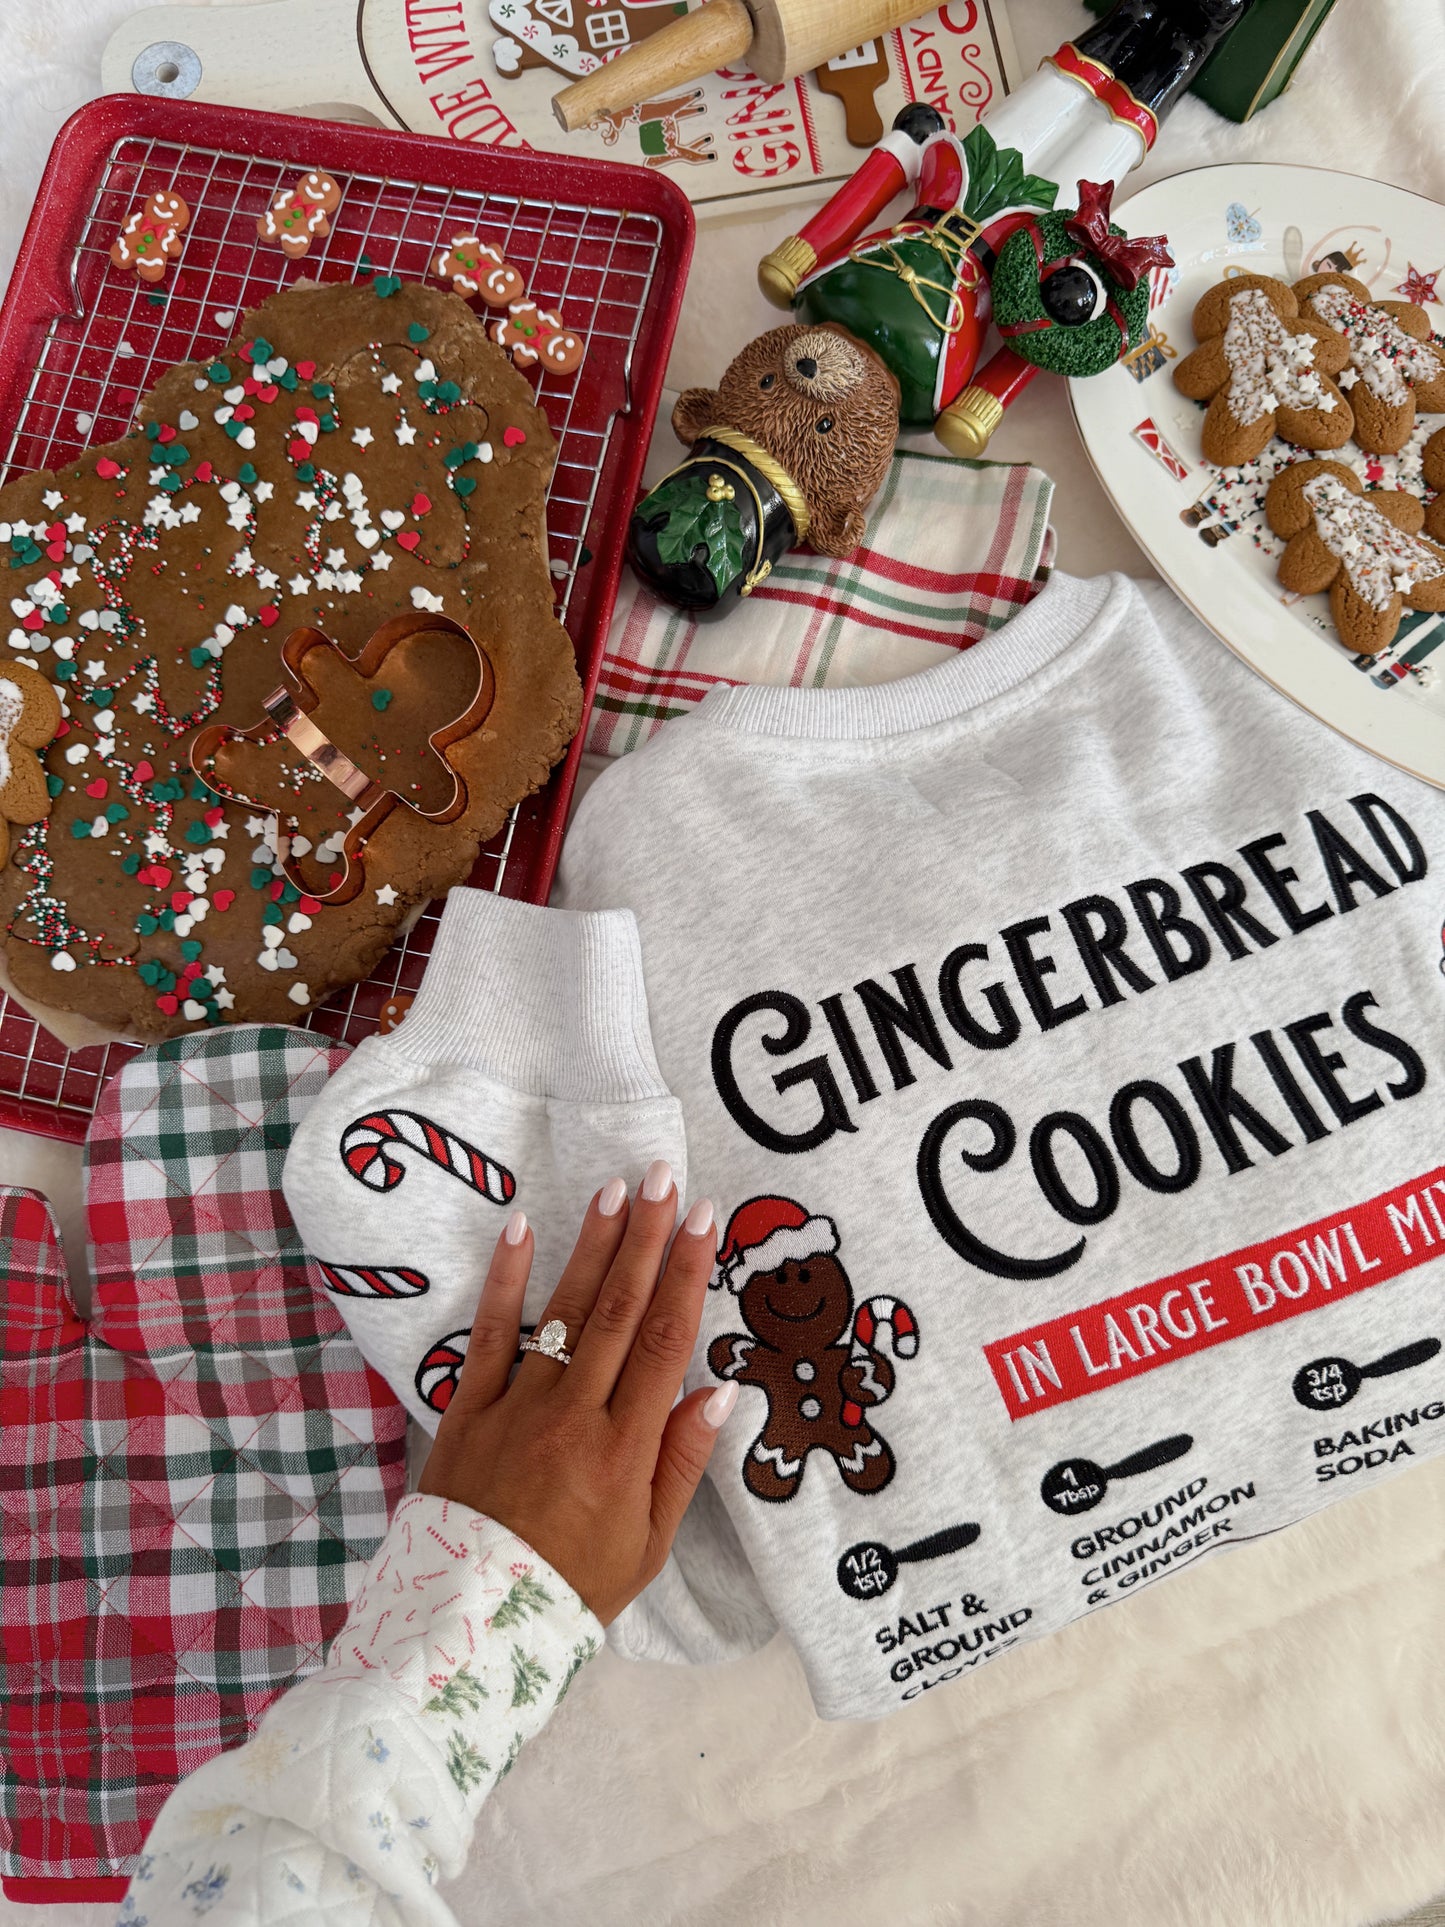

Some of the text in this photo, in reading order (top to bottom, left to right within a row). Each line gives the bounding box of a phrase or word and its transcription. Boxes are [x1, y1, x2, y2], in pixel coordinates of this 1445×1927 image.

[910, 27, 956, 134] ANDY
[711, 793, 1428, 1154] GINGERBREAD
[917, 991, 1427, 1280] COOKIES
[1001, 1180, 1445, 1403] IN LARGE BOWL MI
[1306, 1363, 1344, 1387] 3/4
[1310, 1383, 1347, 1401] tsp
[1313, 1401, 1445, 1458] BAKING
[1315, 1439, 1416, 1482] SODA
[1053, 1484, 1100, 1507] Tbsp
[1062, 1467, 1079, 1488] 1
[1070, 1477, 1208, 1559] GROUND
[1081, 1481, 1256, 1586] CINNAMON
[846, 1547, 882, 1575] 1/2
[853, 1569, 888, 1591] tsp
[1087, 1518, 1234, 1605] & GINGER
[875, 1593, 989, 1655] SALT &
[890, 1608, 1033, 1682] GROUND
